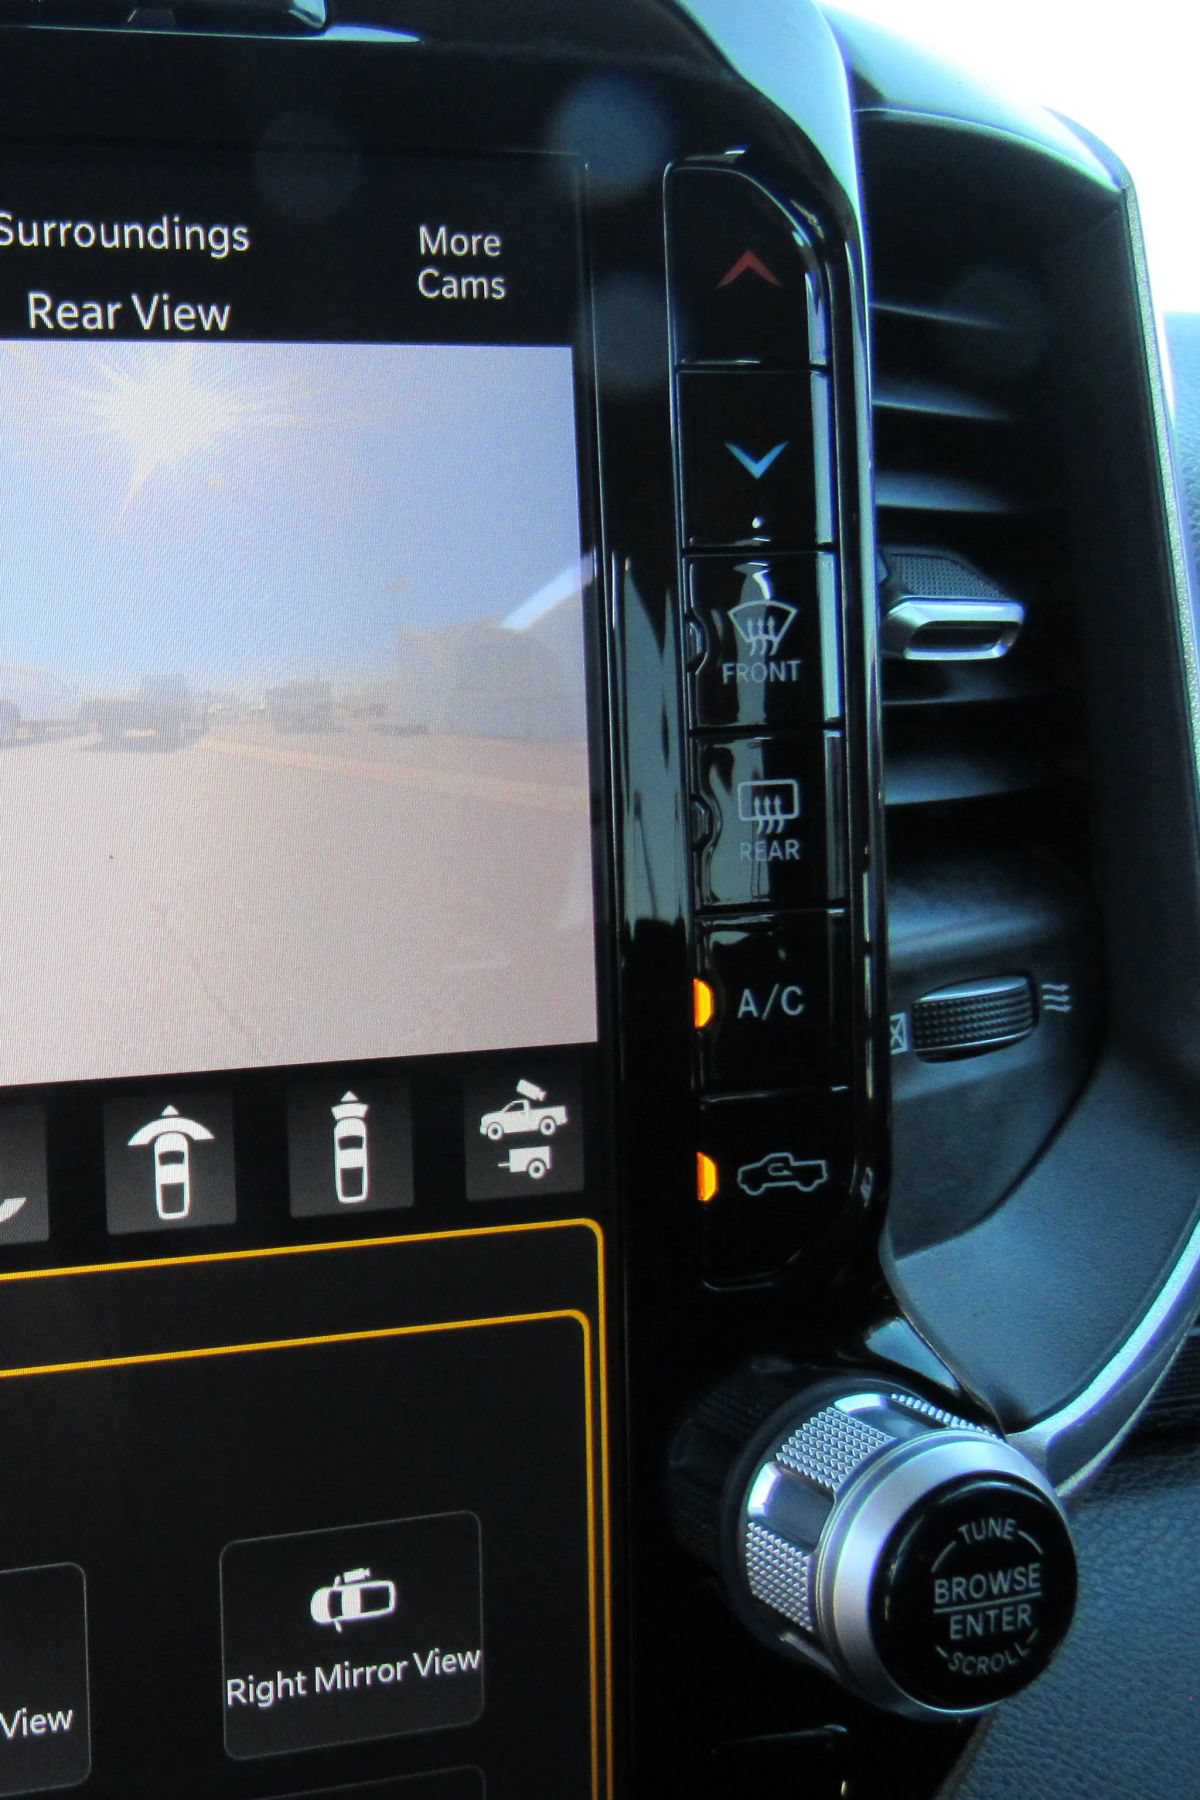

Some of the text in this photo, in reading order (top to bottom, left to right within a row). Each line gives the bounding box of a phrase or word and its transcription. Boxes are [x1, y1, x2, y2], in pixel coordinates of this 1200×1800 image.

[418, 223, 502, 258] More
[417, 267, 506, 301] Cams
[27, 291, 231, 332] Rear View
[722, 659, 801, 685] FRONT
[739, 839, 801, 862] REAR
[736, 982, 805, 1021] A/C
[958, 1517, 1017, 1545] TUNE
[933, 1562, 1042, 1605] BROWSE
[949, 1603, 1033, 1640] ENTER
[947, 1641, 1031, 1676] SCROLL
[226, 1646, 482, 1709] Right Mirror View
